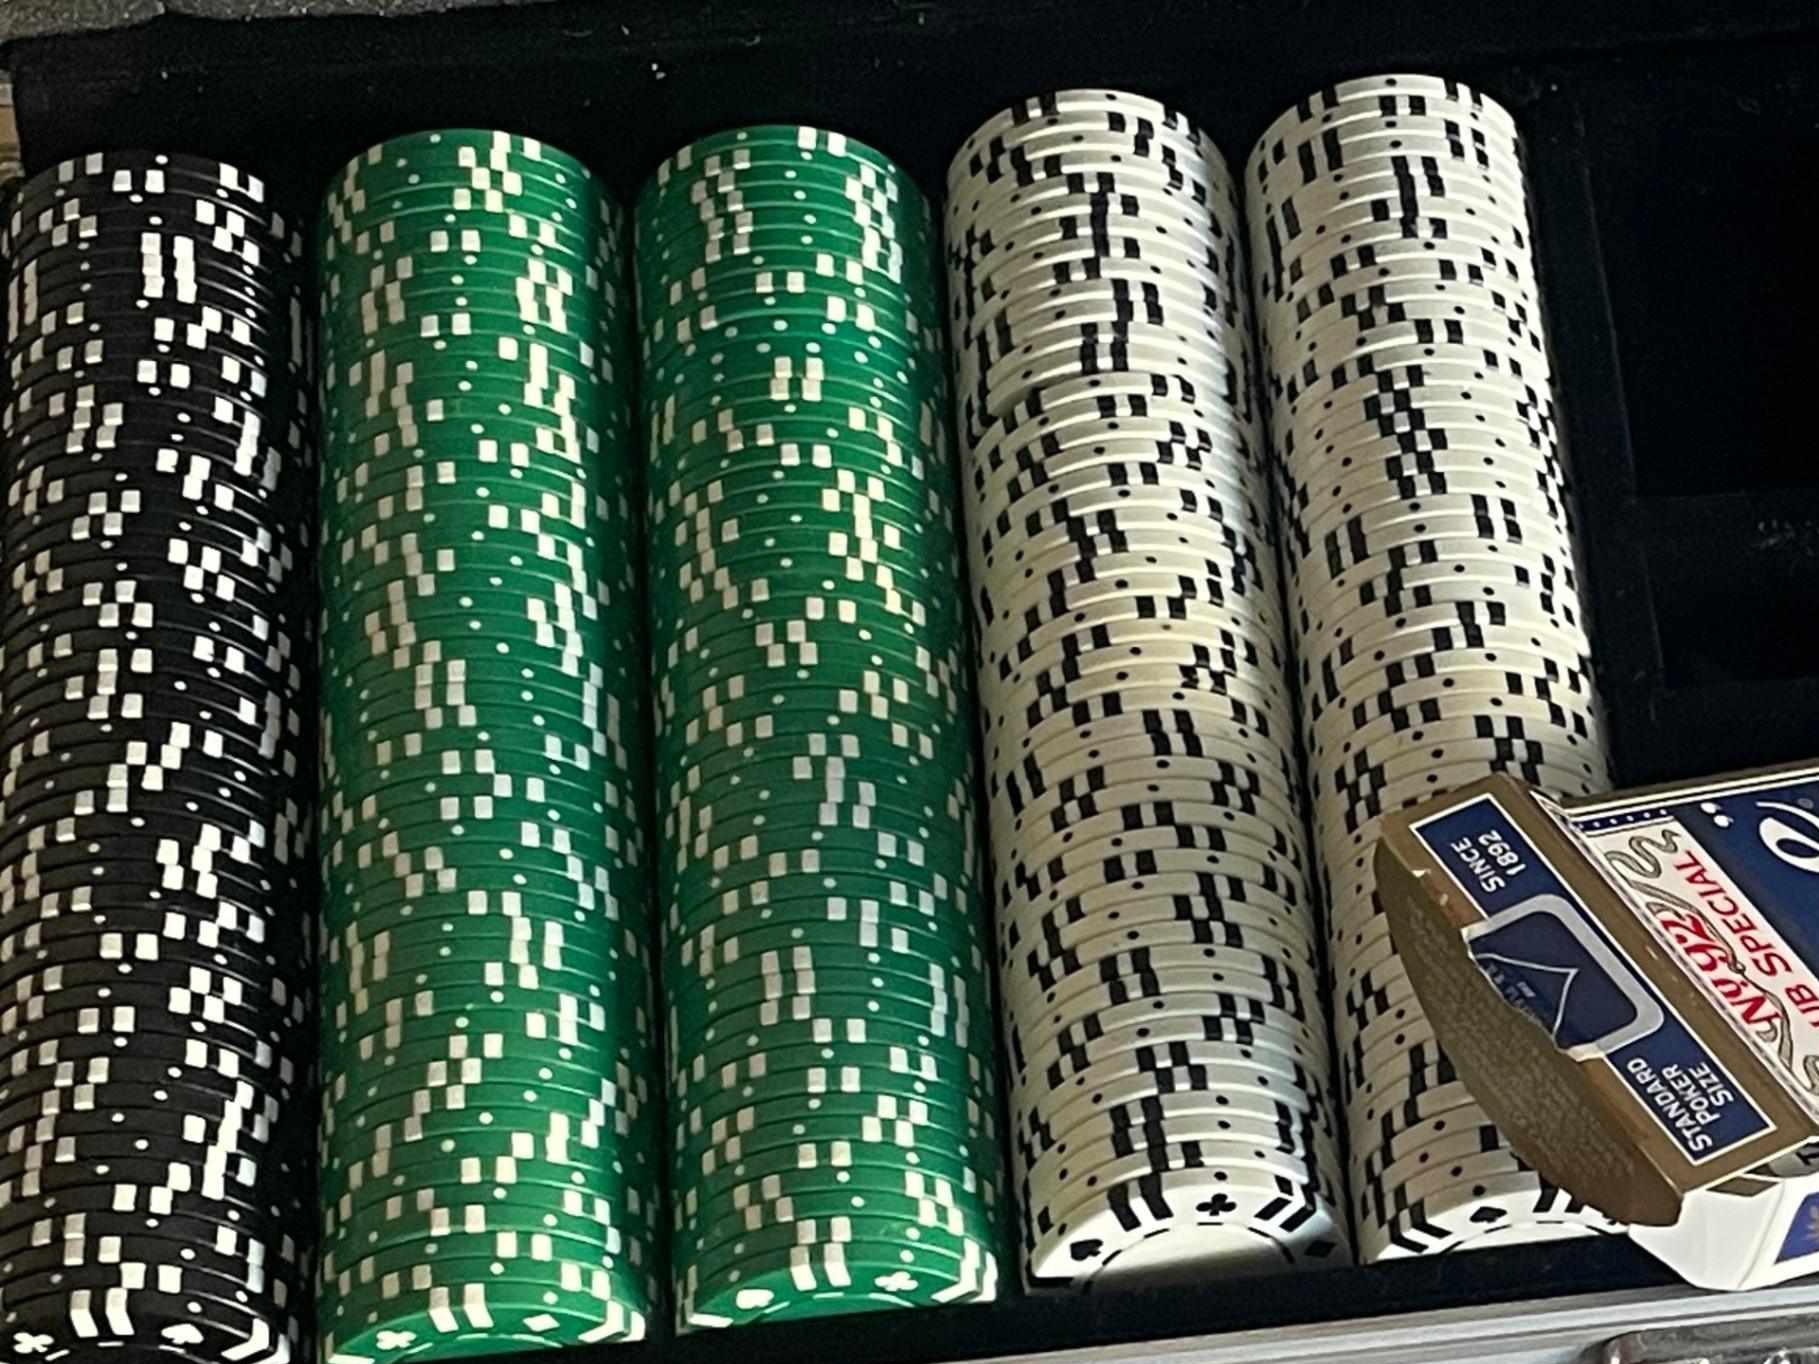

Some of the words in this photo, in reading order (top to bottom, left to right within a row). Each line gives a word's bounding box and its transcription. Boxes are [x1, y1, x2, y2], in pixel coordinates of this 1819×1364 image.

[1450, 837, 1506, 892] SINCE
[1478, 829, 1527, 876] 1892
[1661, 912, 1729, 973] 92
[1674, 850, 1793, 977] SPECIAL
[1626, 1057, 1713, 1152] STANDARD
[1661, 1063, 1721, 1125] POKER
[1688, 1061, 1734, 1107] SIZE
